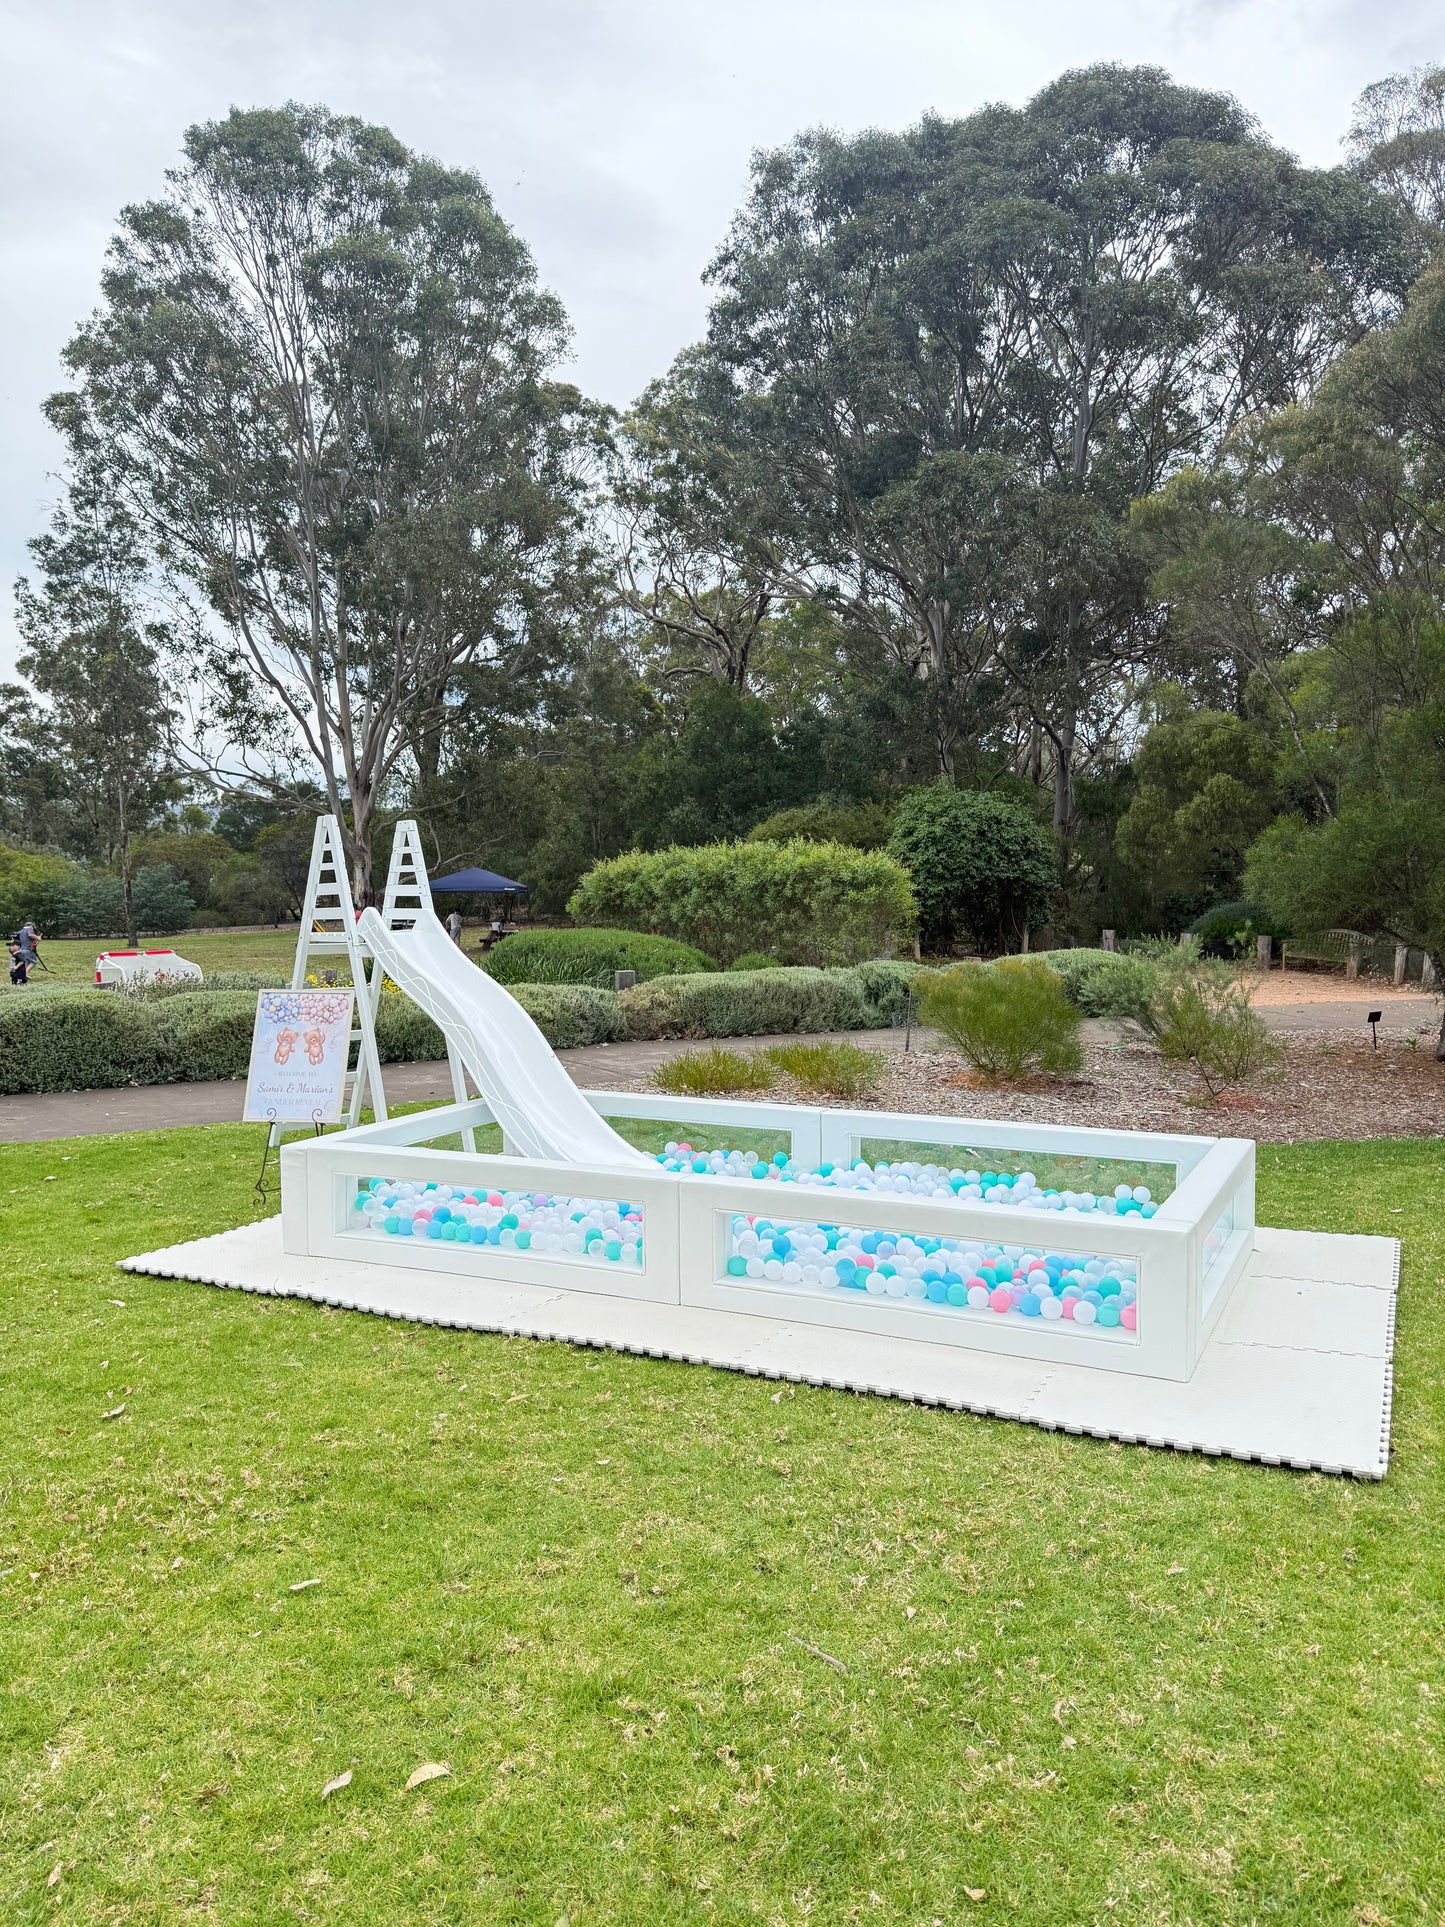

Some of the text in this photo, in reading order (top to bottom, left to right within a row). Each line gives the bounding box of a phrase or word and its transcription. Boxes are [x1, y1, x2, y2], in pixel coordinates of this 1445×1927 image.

[257, 1081, 334, 1094] Samir & Marian's
